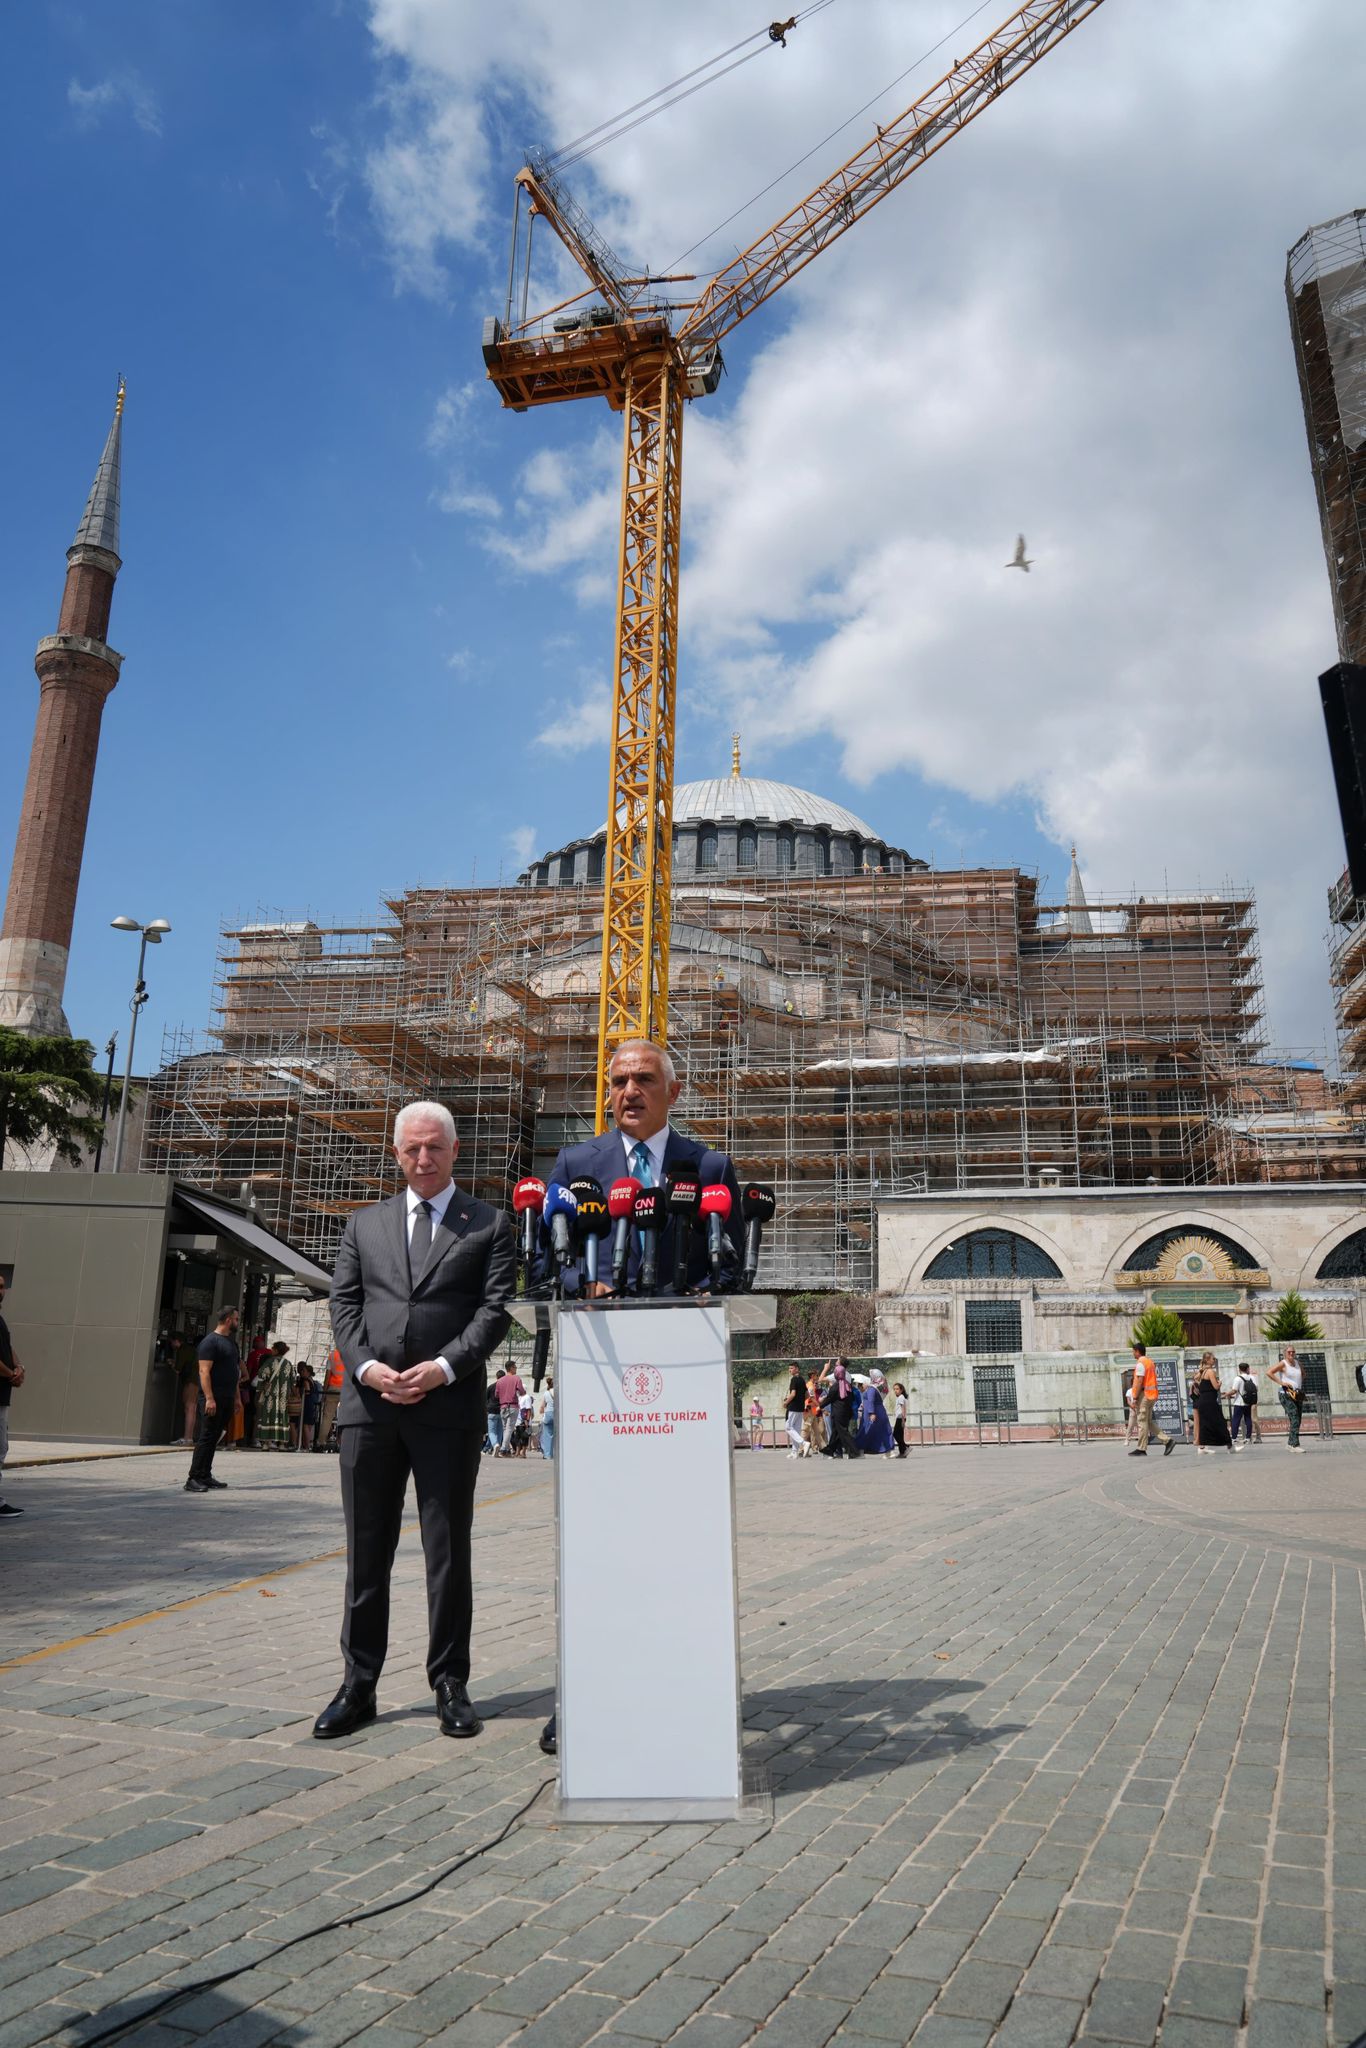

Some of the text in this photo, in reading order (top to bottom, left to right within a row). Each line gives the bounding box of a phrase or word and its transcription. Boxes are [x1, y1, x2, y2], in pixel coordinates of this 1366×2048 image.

[577, 1201, 606, 1215] NTV
[635, 1196, 655, 1209] CNN
[579, 1410, 707, 1423] T.C. KÜLTÜR VE TURİZM
[613, 1423, 674, 1436] BAKANLIĞI
